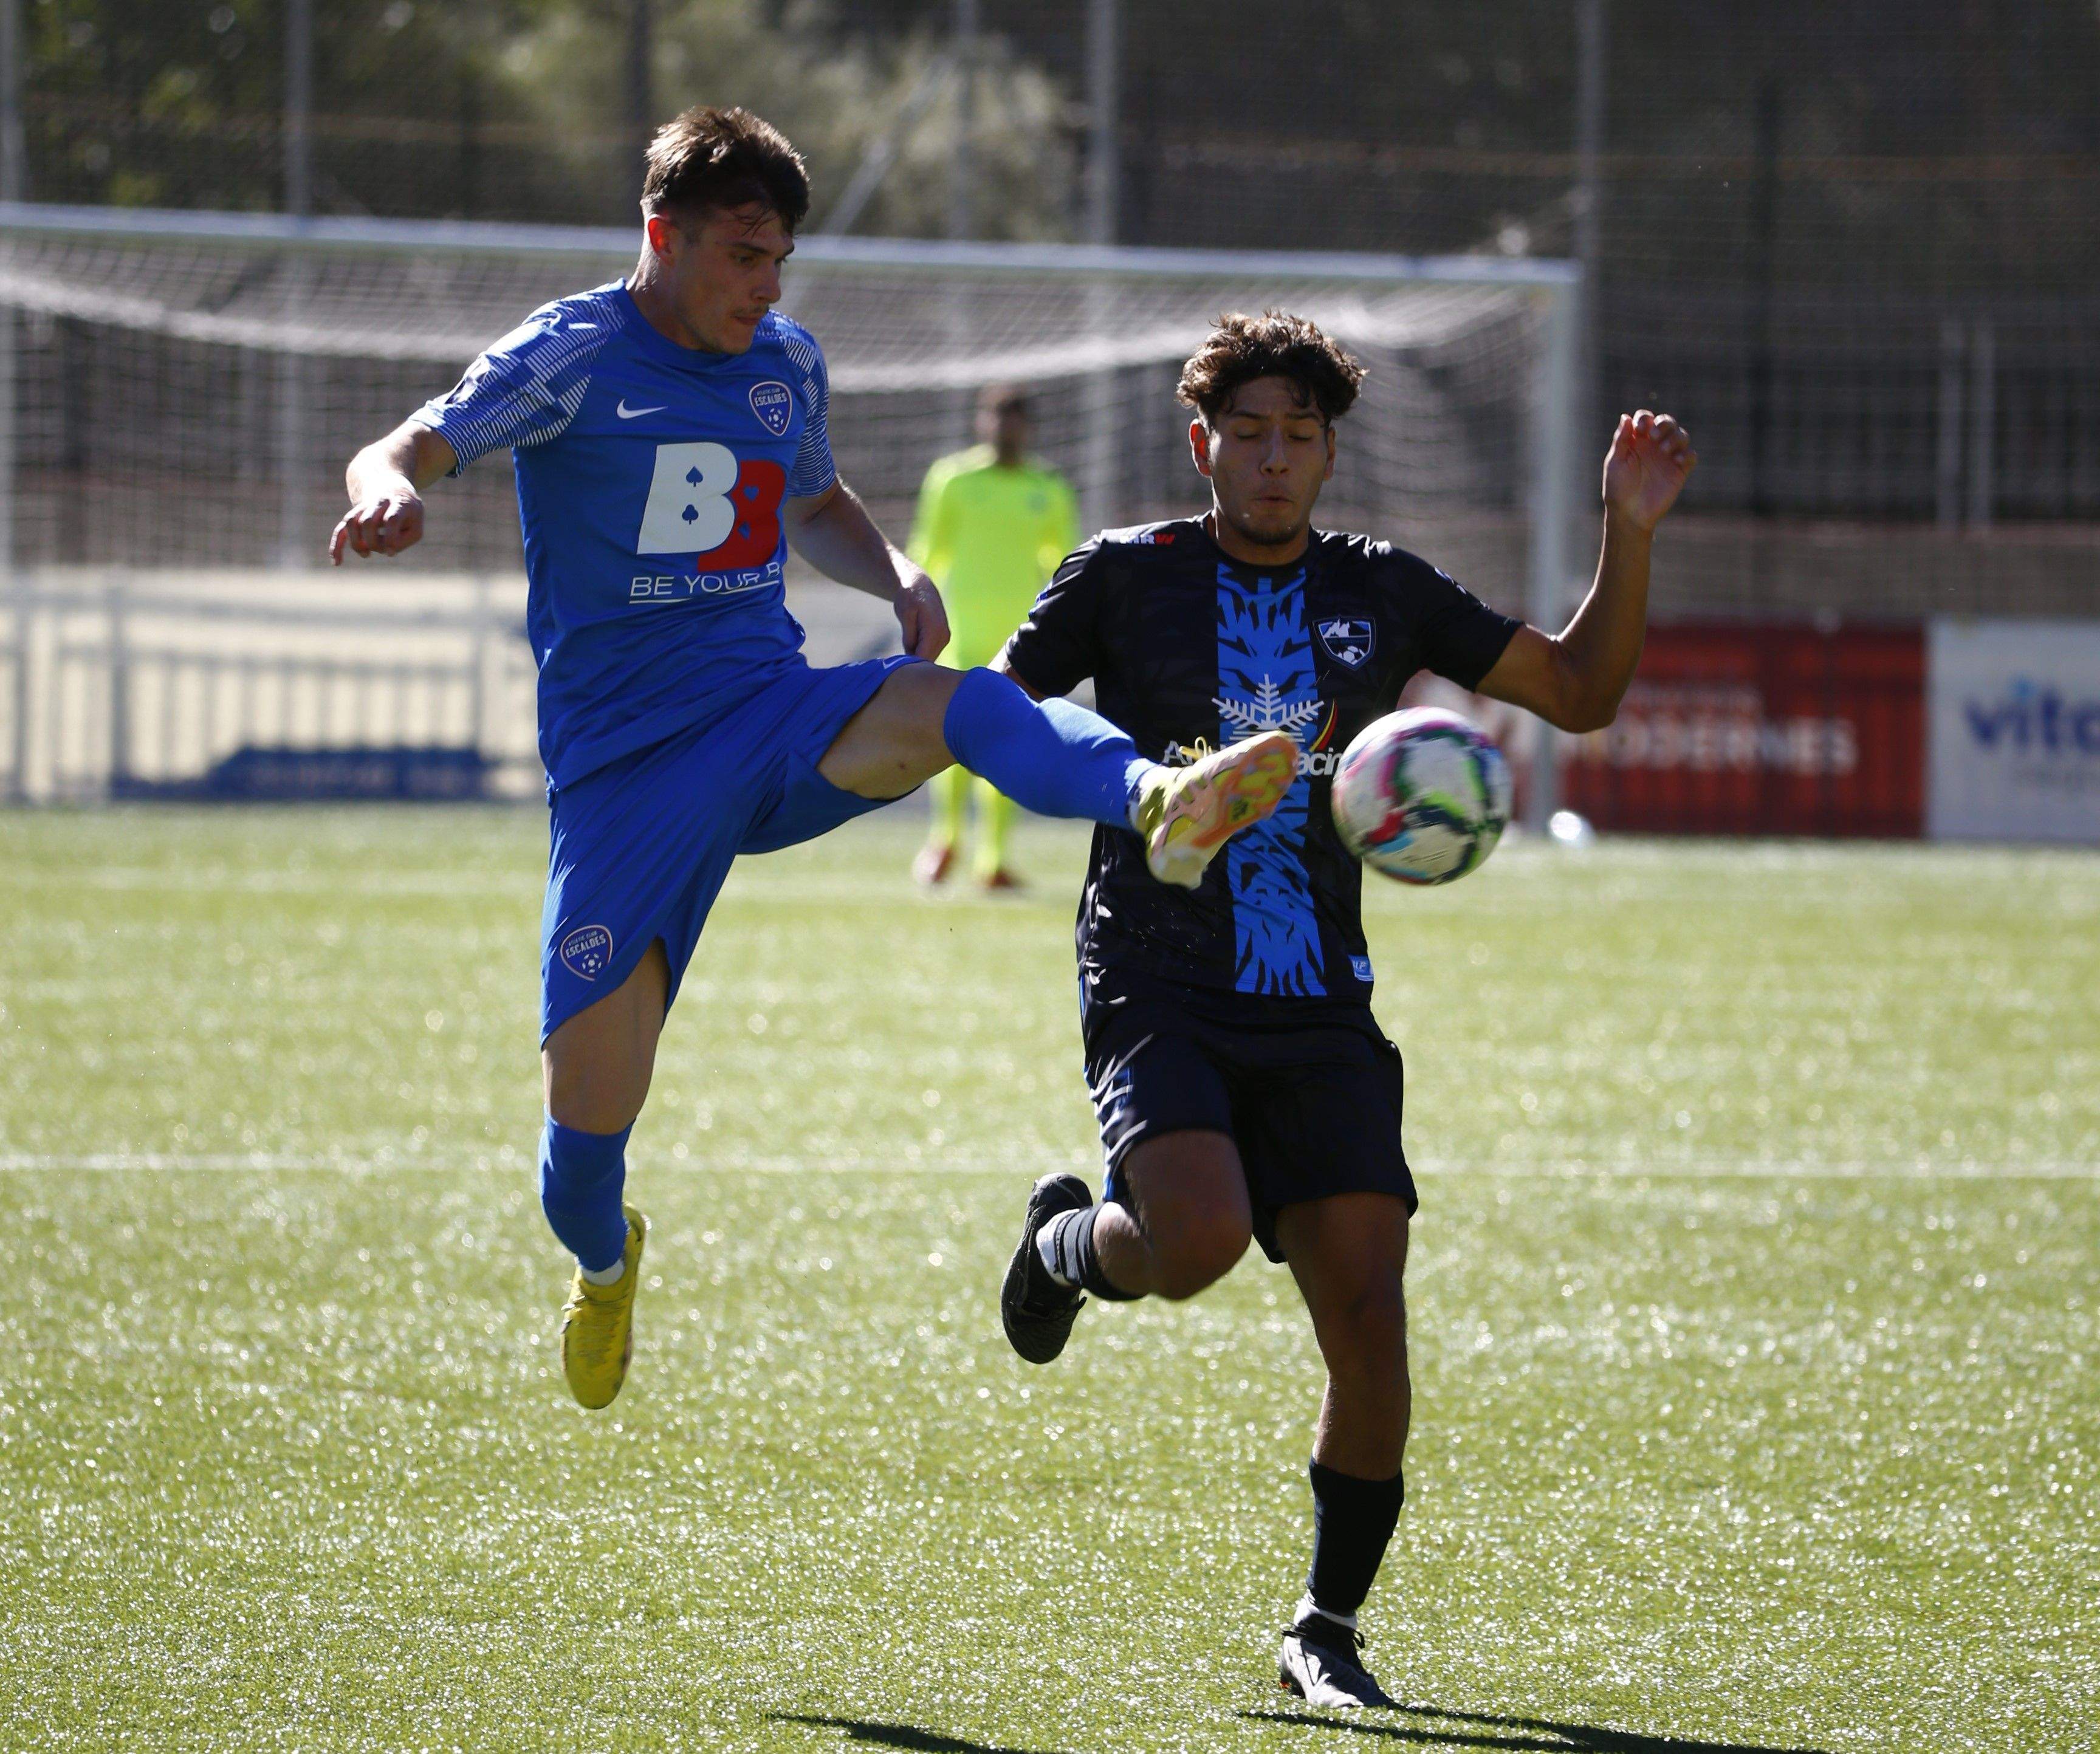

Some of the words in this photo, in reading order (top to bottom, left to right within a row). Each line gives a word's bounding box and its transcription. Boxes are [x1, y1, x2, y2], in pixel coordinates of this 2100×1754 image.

[754, 392, 787, 406] ESCALDES
[630, 576, 674, 597] BE
[684, 573, 760, 594] YOUR
[766, 561, 781, 578] B
[566, 933, 606, 959] ESCALDES
